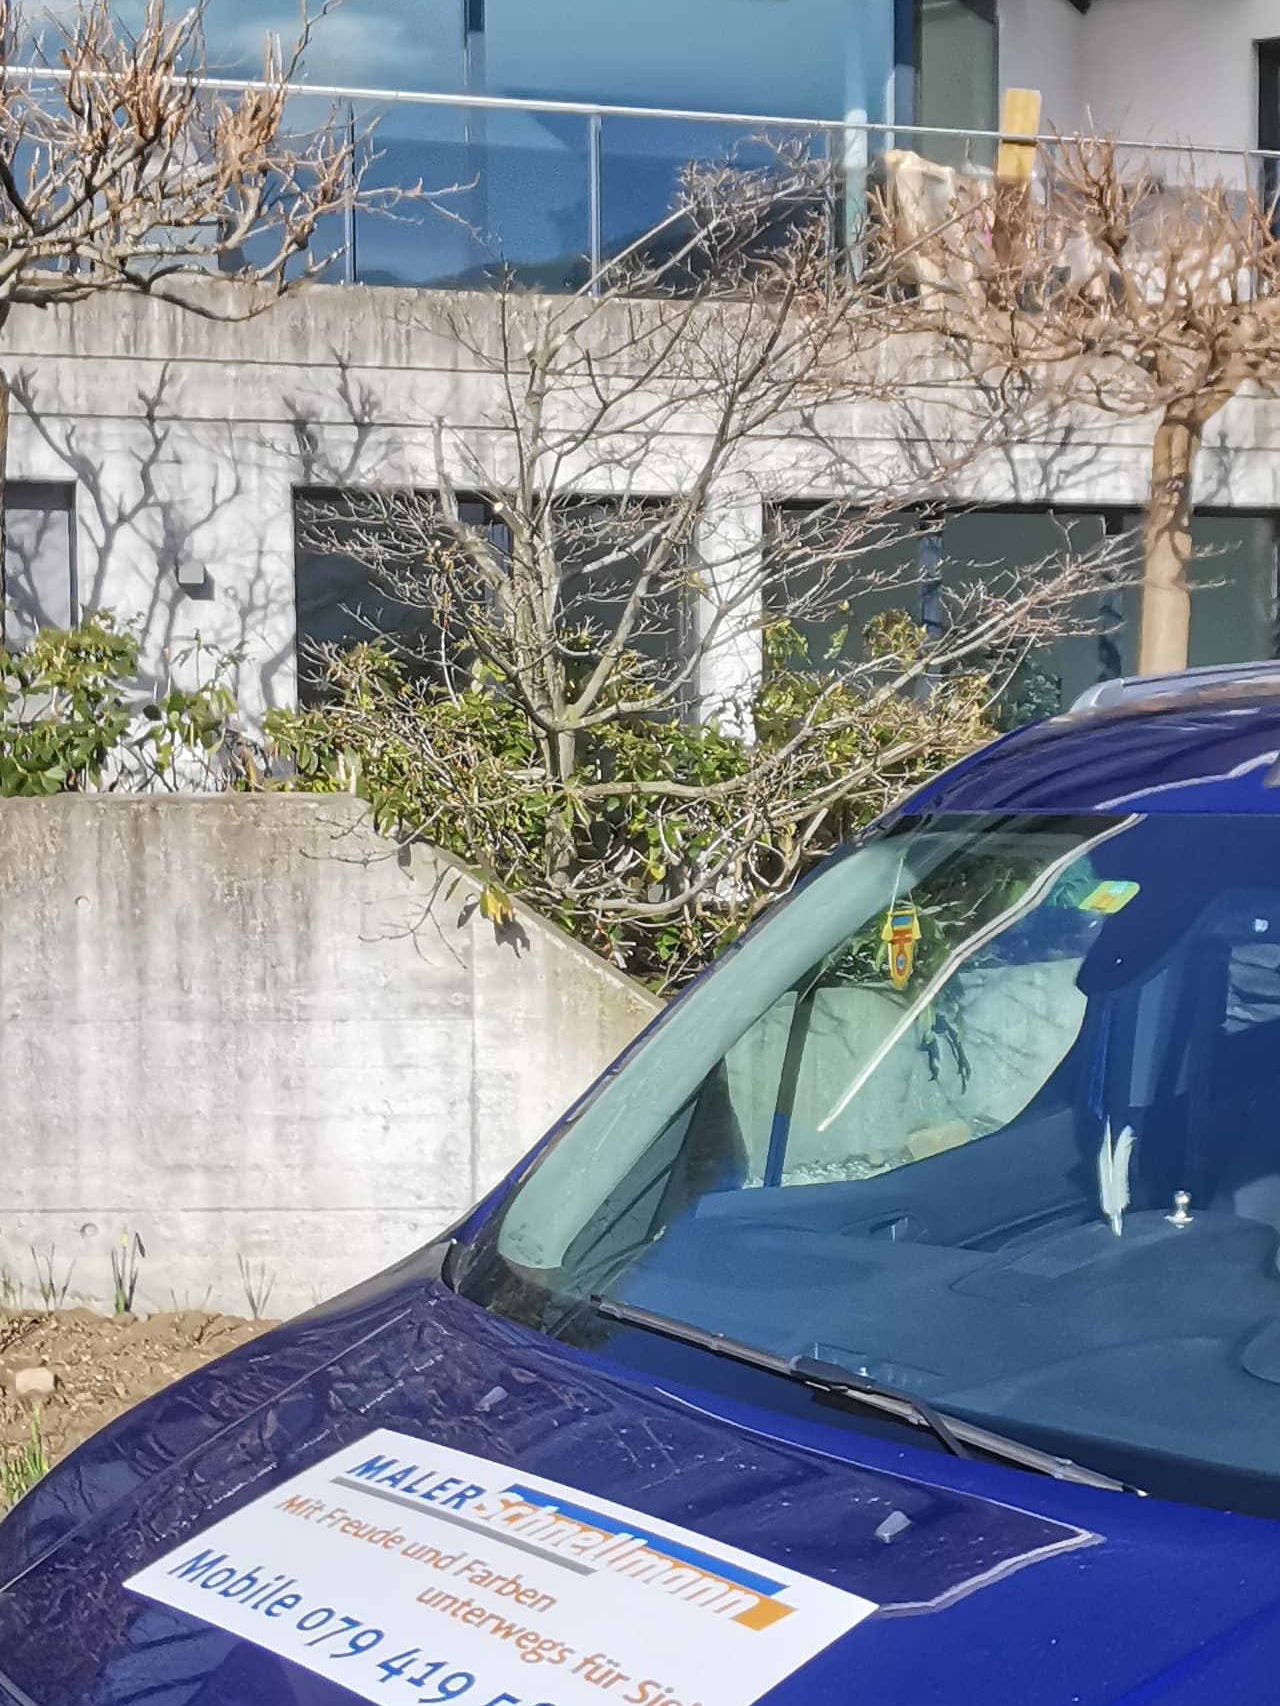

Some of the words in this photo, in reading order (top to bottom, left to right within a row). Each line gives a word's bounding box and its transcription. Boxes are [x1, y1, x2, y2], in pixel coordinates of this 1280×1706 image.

[273, 1494, 328, 1520] Mit
[318, 1507, 406, 1551] Freude
[400, 1537, 467, 1572] und
[460, 1558, 557, 1614] Farben
[167, 1548, 304, 1618] Mobile
[295, 1606, 385, 1660] 079
[375, 1647, 477, 1705] 419
[416, 1586, 575, 1665] unterwegs
[570, 1652, 631, 1690] für
